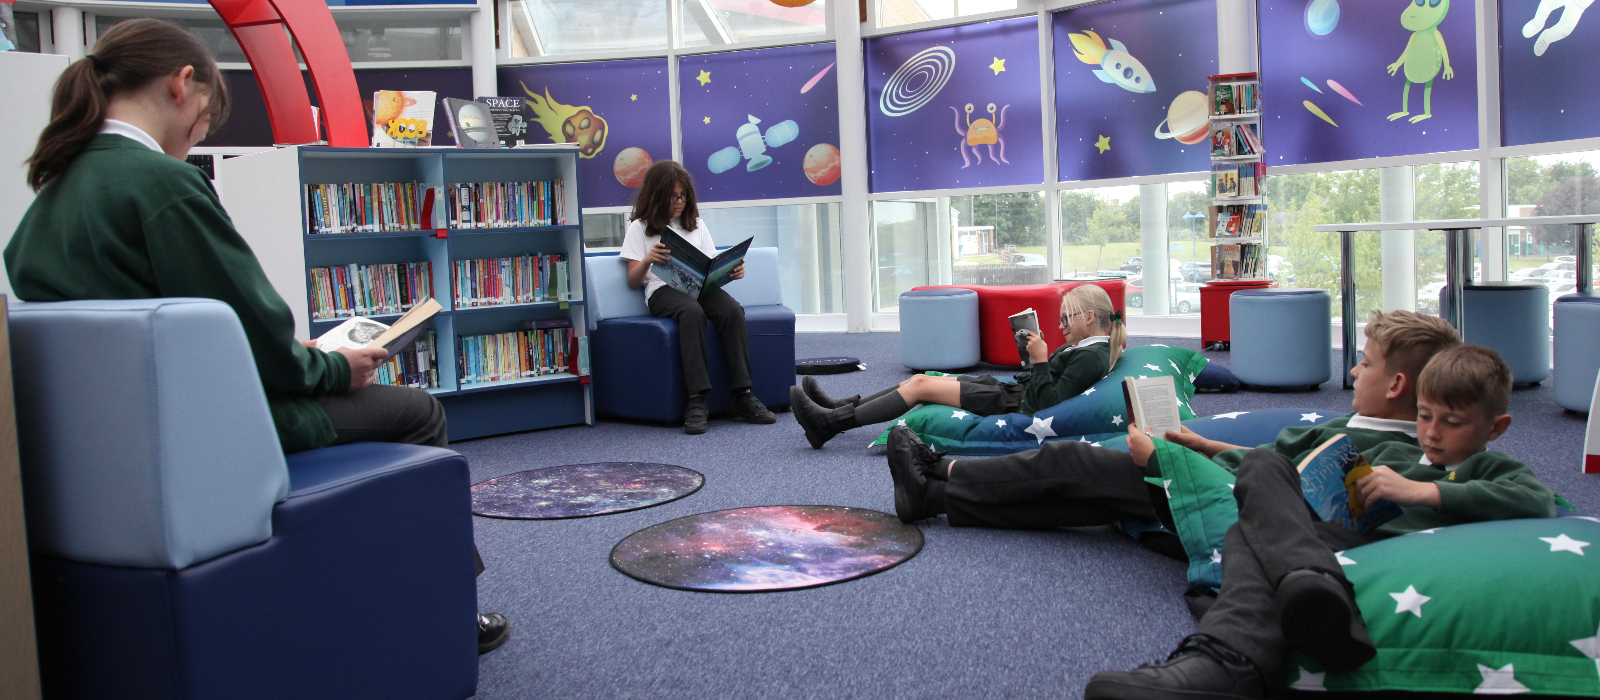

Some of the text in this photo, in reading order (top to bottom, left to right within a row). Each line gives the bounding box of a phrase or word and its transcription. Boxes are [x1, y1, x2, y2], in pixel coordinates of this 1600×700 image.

[486, 98, 520, 107] SPACE
[581, 367, 588, 375] G
[1301, 447, 1360, 501] SLIPPERS
